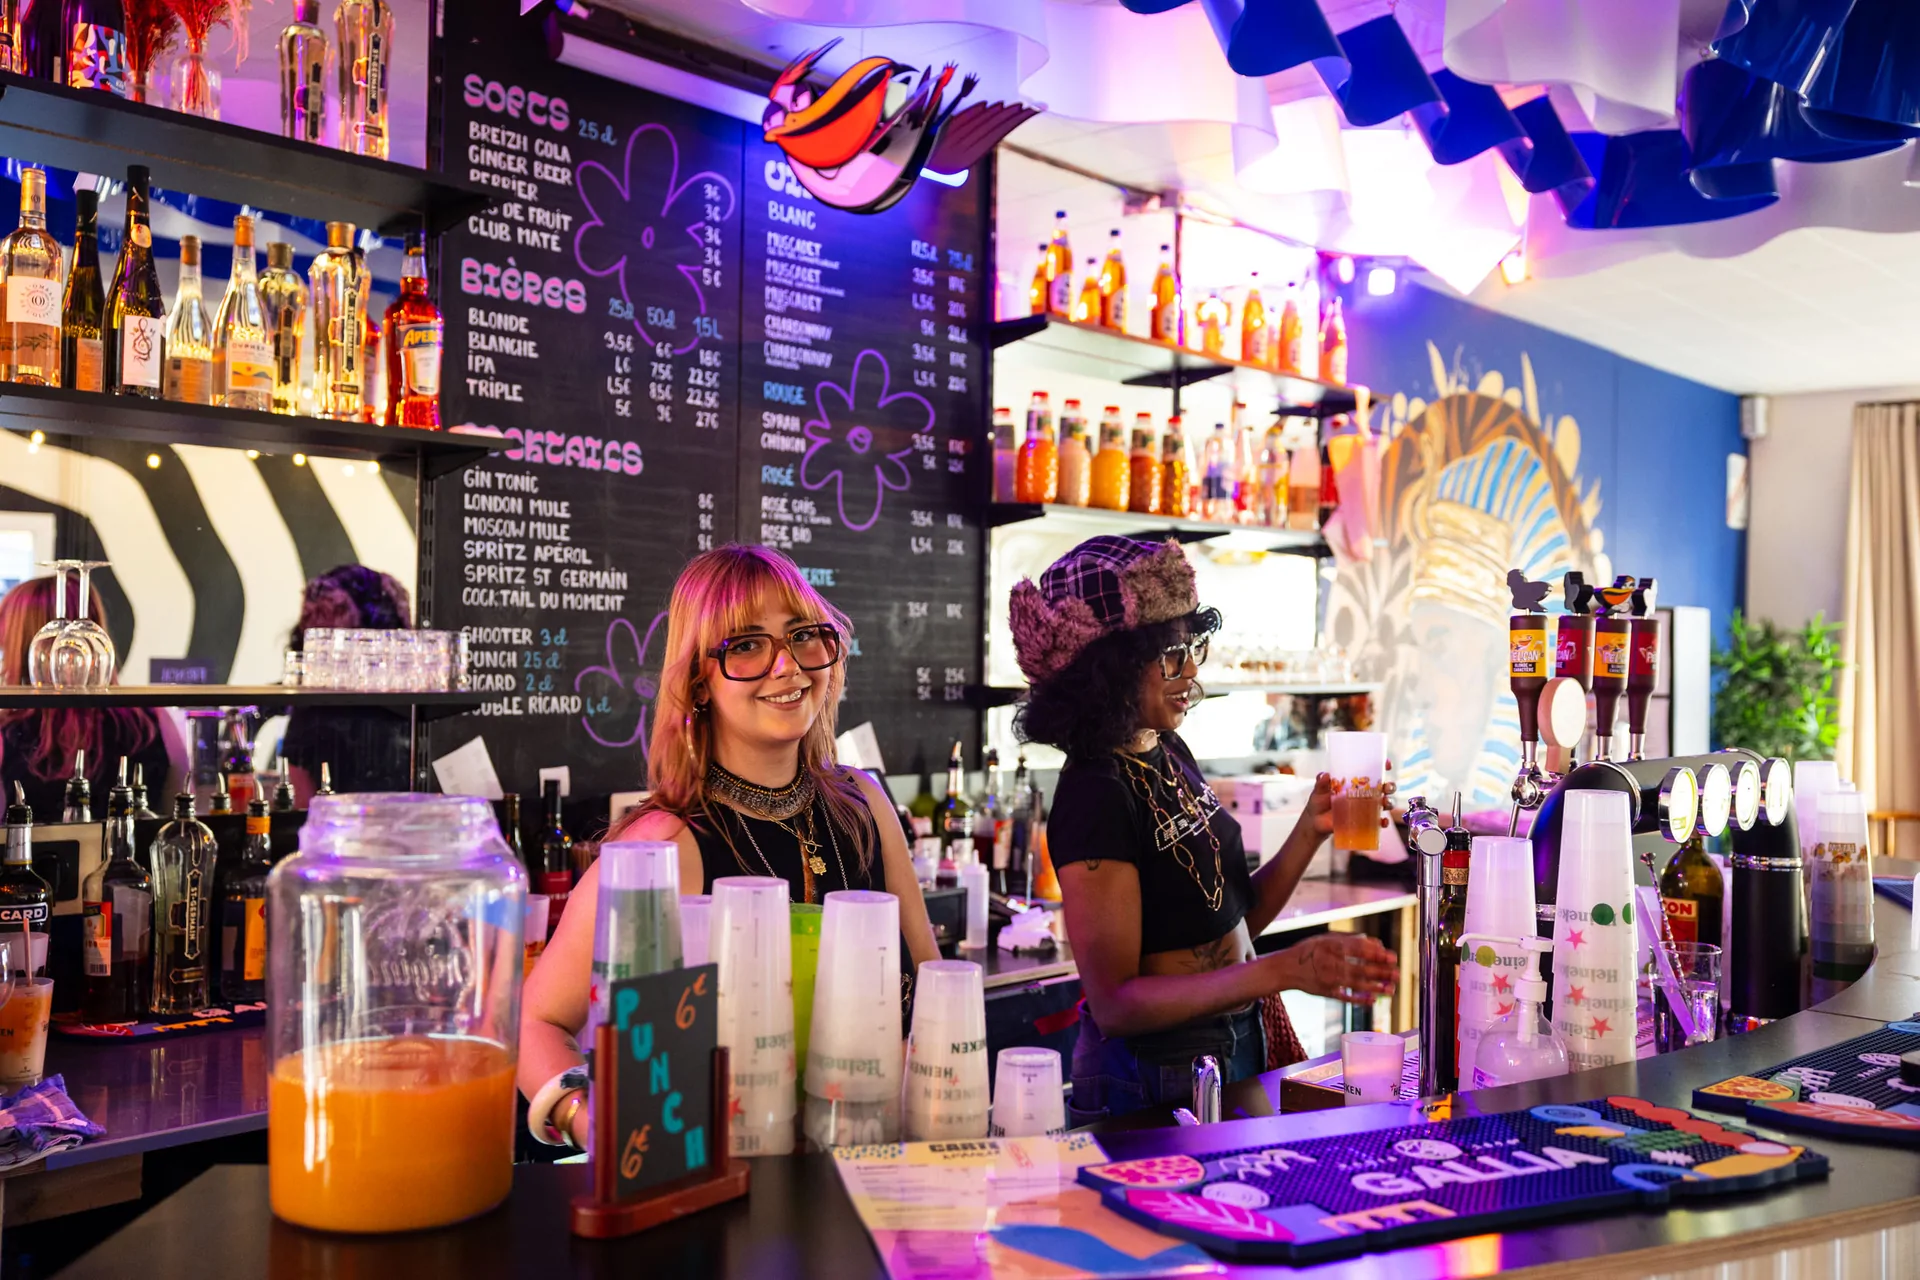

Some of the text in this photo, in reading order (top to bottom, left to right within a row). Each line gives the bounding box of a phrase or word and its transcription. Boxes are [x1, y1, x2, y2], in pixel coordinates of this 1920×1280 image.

[464, 74, 569, 131] SOFTS
[578, 119, 598, 139] 25
[469, 121, 571, 163] BREIZH COLA
[469, 144, 572, 185] GINGER BEER
[703, 184, 720, 201] 3€
[503, 201, 523, 221] DE
[528, 205, 572, 231] FRUIT
[704, 204, 721, 222] 3€
[768, 201, 816, 230] BLANC
[469, 215, 561, 252] CLUB MATÉ
[704, 226, 721, 245] 3€
[704, 247, 721, 266] 3€
[461, 256, 586, 313] BIÈRES
[702, 268, 721, 287] 5€
[468, 307, 529, 334] BLONDE
[469, 331, 538, 358] BLANCHE
[656, 341, 673, 359] 6€
[468, 351, 495, 375] IPA
[466, 376, 523, 401] TRIPLE
[763, 381, 806, 405] ROUGE
[616, 399, 632, 417] 5€
[466, 423, 643, 475] CKTAILS
[464, 466, 539, 493] GIN TONIC
[464, 493, 522, 515] LONDON
[530, 499, 571, 518] MULE
[464, 517, 525, 538] MOSCOW
[529, 522, 570, 541] MULE
[464, 539, 592, 565] SPRITZ APÉROL
[464, 562, 627, 590] SPRITZ ST GERMAIN
[462, 586, 625, 611] COCKTAIL DU MOMENT
[462, 625, 533, 645] SHOOTER
[540, 631, 550, 645] 3
[524, 651, 542, 668] 25
[526, 676, 536, 691] 2
[529, 693, 581, 714] RICARD
[1, 909, 42, 921] CARD
[675, 973, 707, 1029] 6€
[616, 988, 706, 1170] PUNCH
[620, 1124, 651, 1180] 6€
[1351, 1145, 1610, 1196] GALLIA
